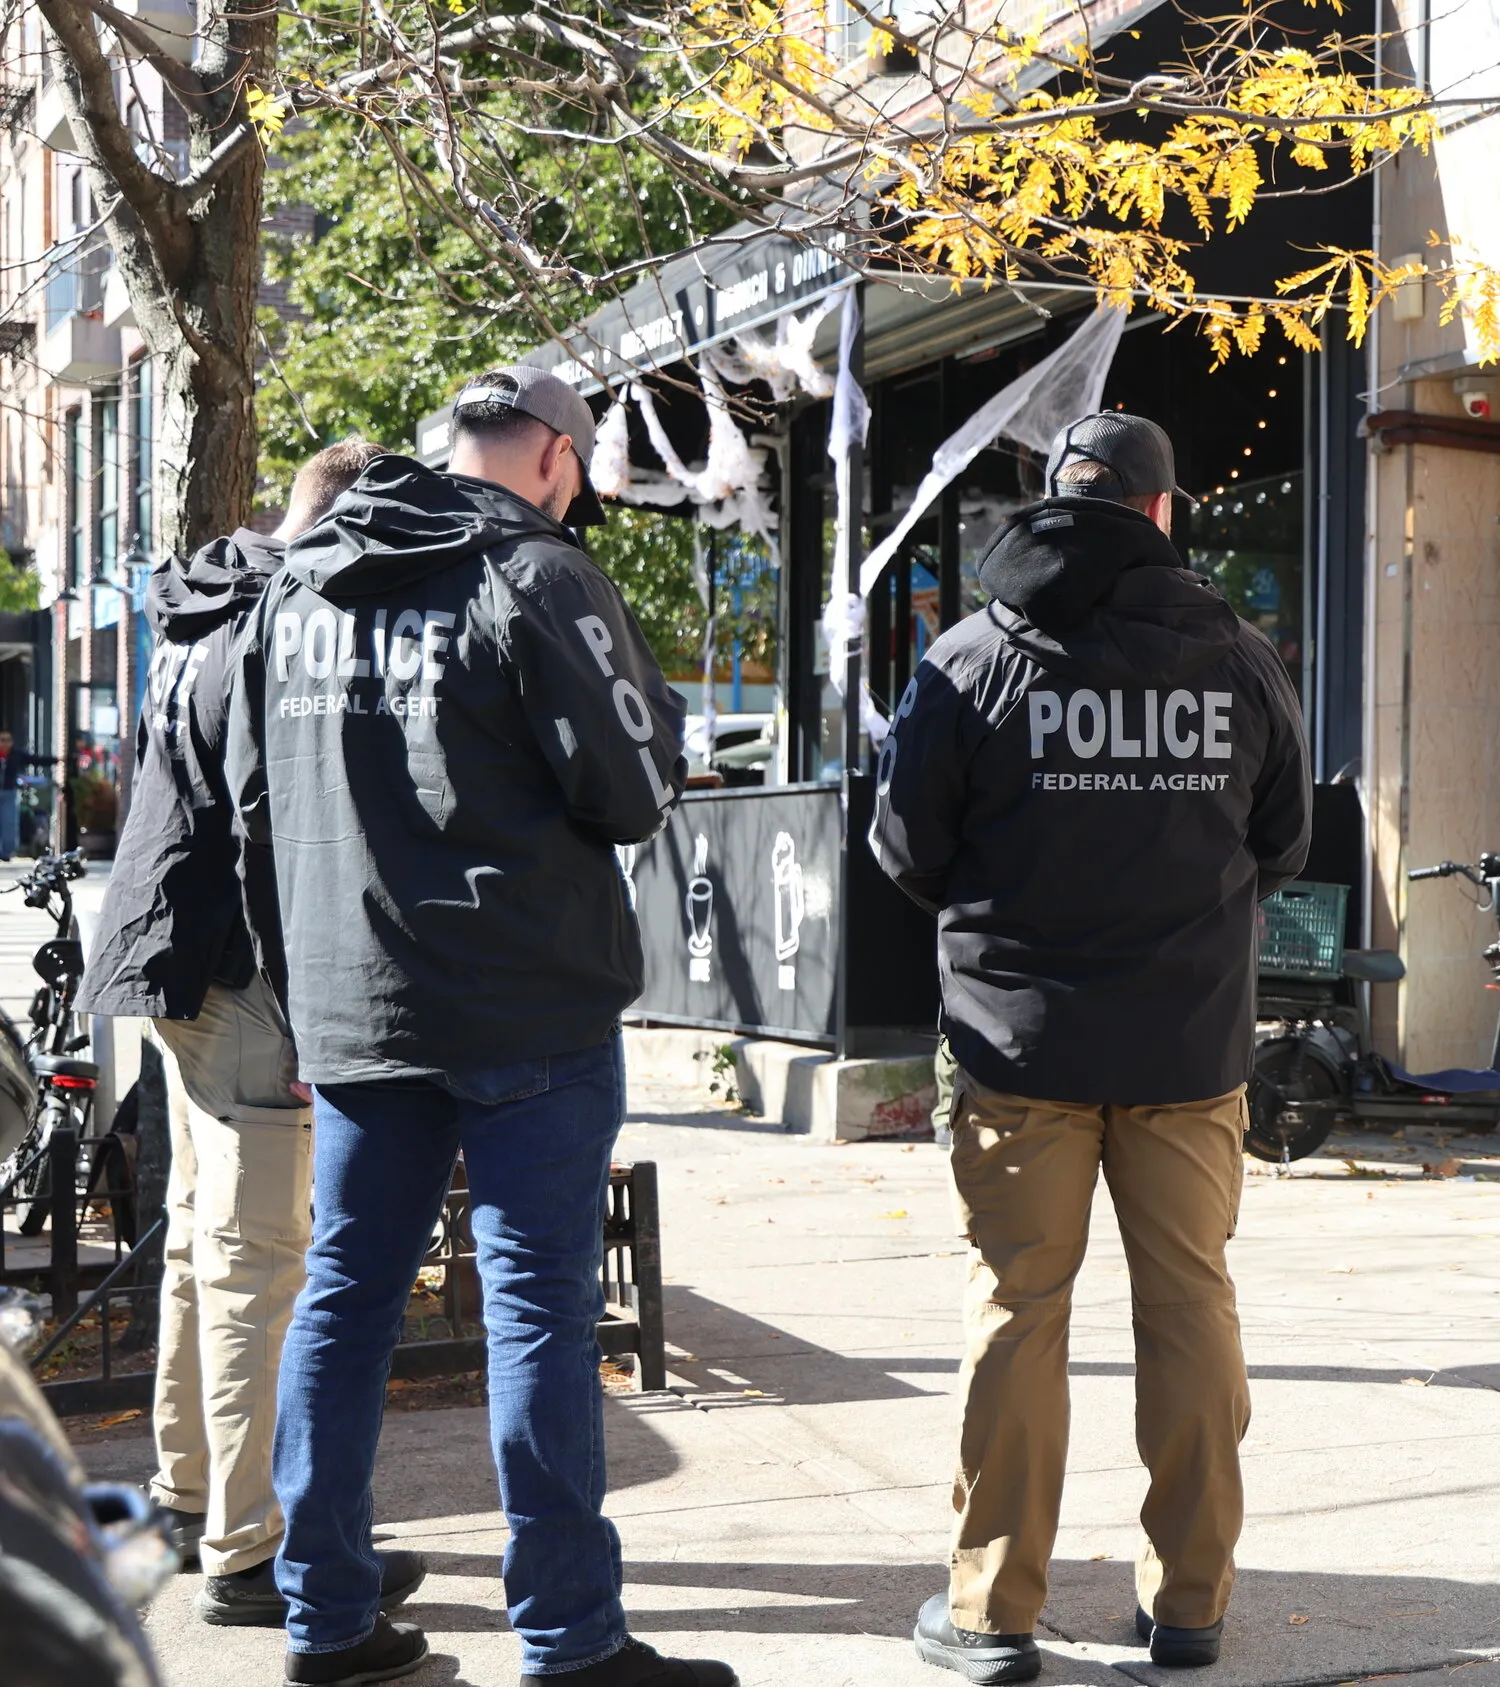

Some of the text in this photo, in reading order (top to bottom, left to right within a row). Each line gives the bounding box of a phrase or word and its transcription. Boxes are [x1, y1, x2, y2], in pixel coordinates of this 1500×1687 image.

[275, 607, 457, 682] POLICE
[280, 693, 442, 718] FEDERAL AGENT
[1028, 688, 1233, 760] POLICE
[1032, 773, 1229, 792] FEDERAL AGENT
